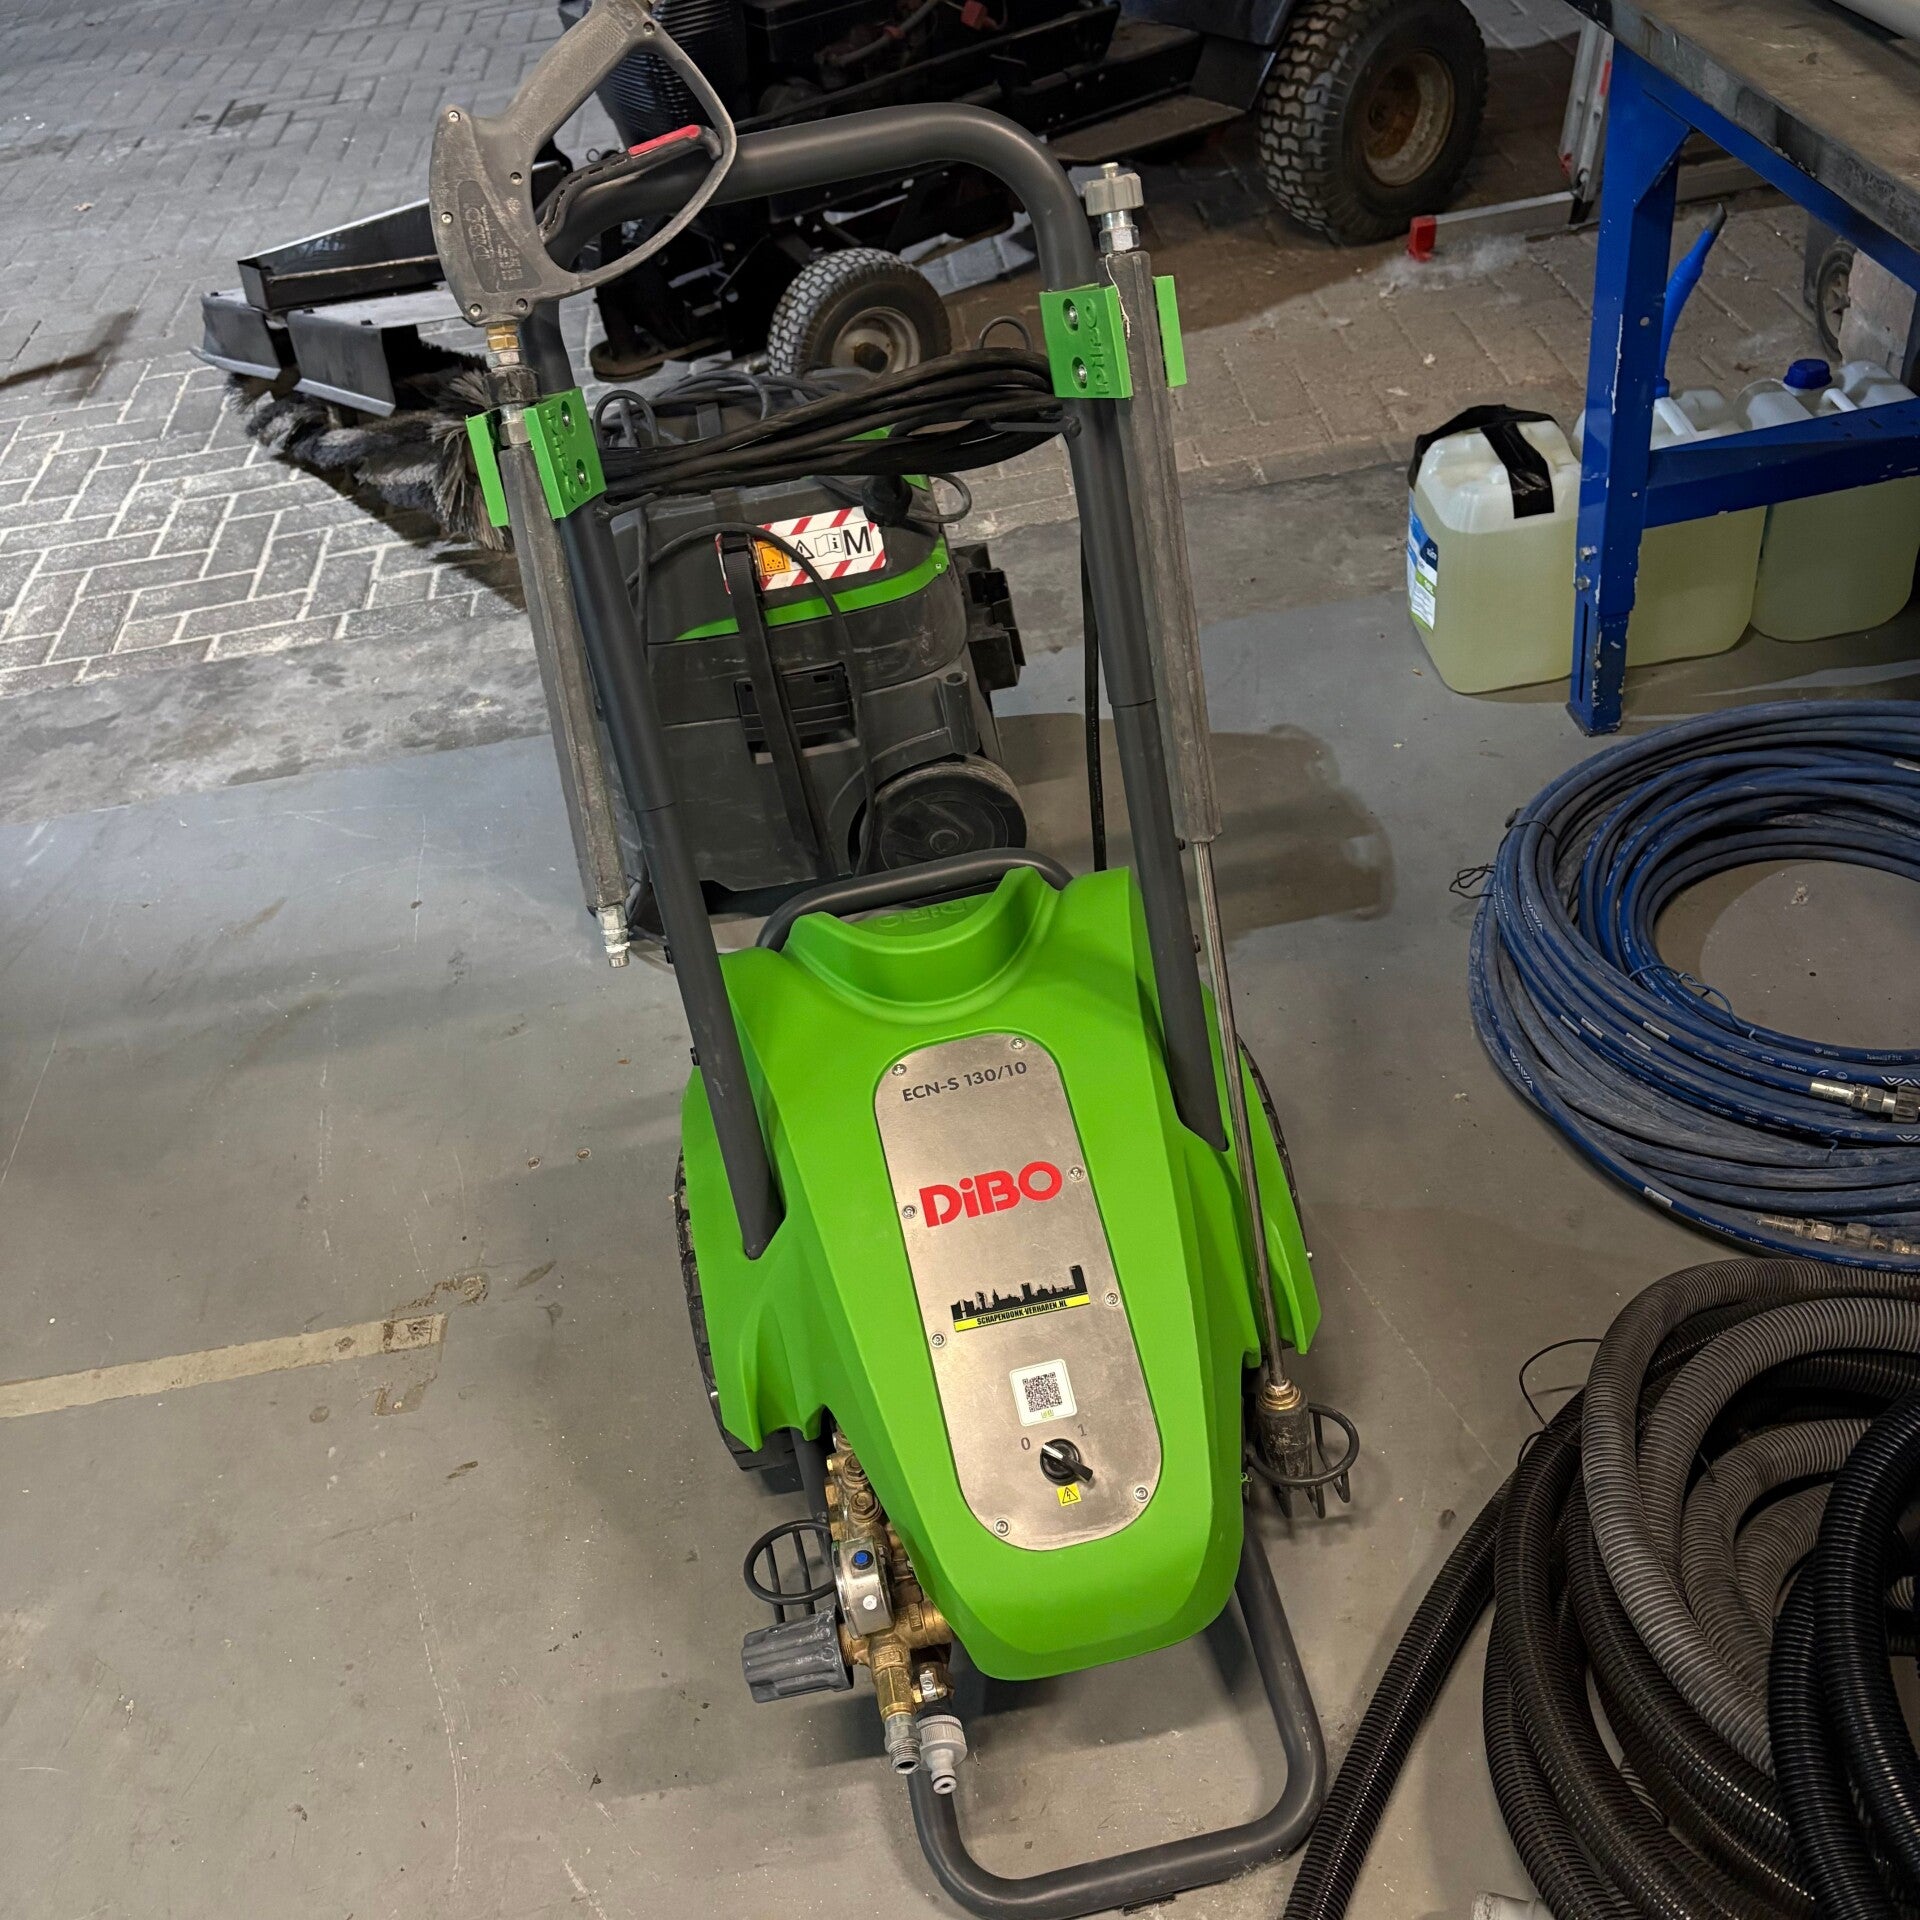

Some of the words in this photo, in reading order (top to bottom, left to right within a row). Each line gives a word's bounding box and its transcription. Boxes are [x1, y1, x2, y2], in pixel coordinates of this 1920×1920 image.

[843, 525, 872, 556] M
[902, 1077, 960, 1101] ECN-S
[963, 1061, 1027, 1087] 130/10
[919, 1161, 1063, 1228] DiBO
[976, 1299, 1068, 1326] SCHAPENDONK-VERHAREN.NL
[1020, 1436, 1031, 1451] 0
[1077, 1423, 1088, 1437] 1
